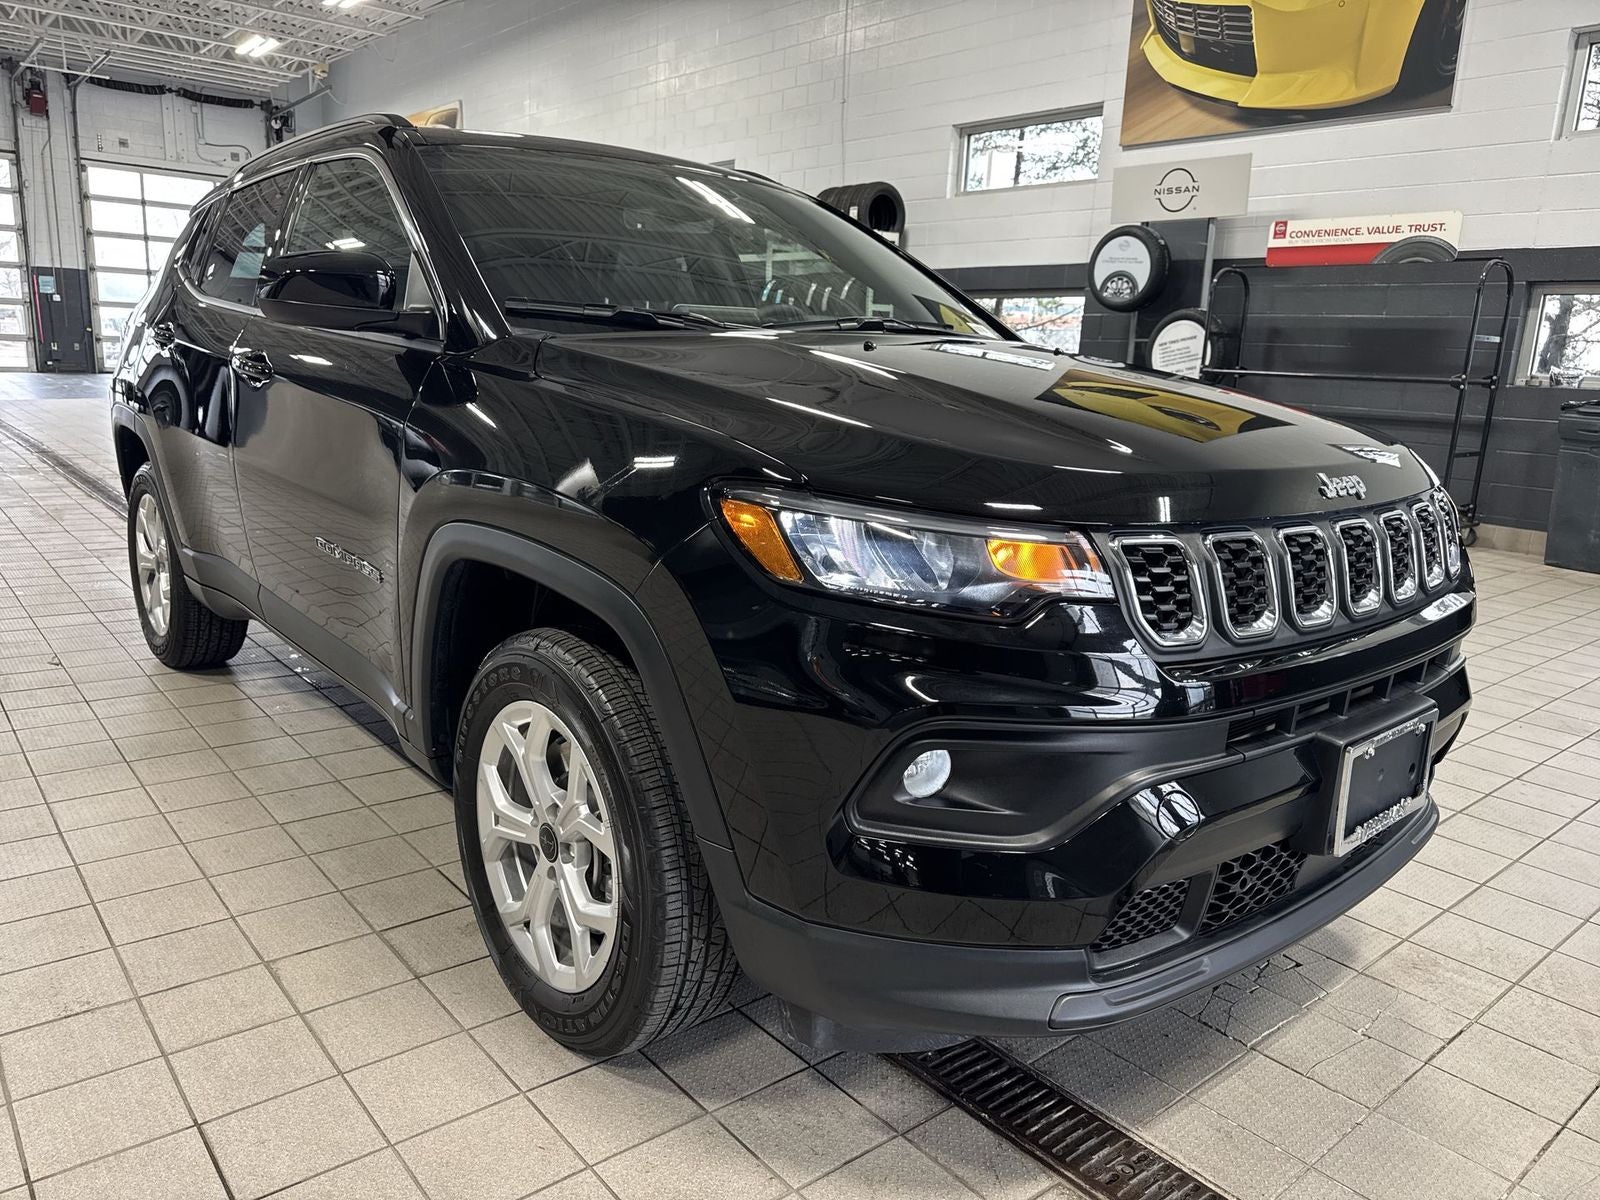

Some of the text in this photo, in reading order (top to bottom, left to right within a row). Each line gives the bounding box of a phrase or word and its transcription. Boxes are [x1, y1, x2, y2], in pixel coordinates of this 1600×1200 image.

[1154, 185, 1200, 196] NISSAN
[1289, 222, 1447, 239] CONVENIENCE. VALUE. TRUST.
[1316, 472, 1367, 500] Jeep
[315, 536, 384, 583] COMPASS
